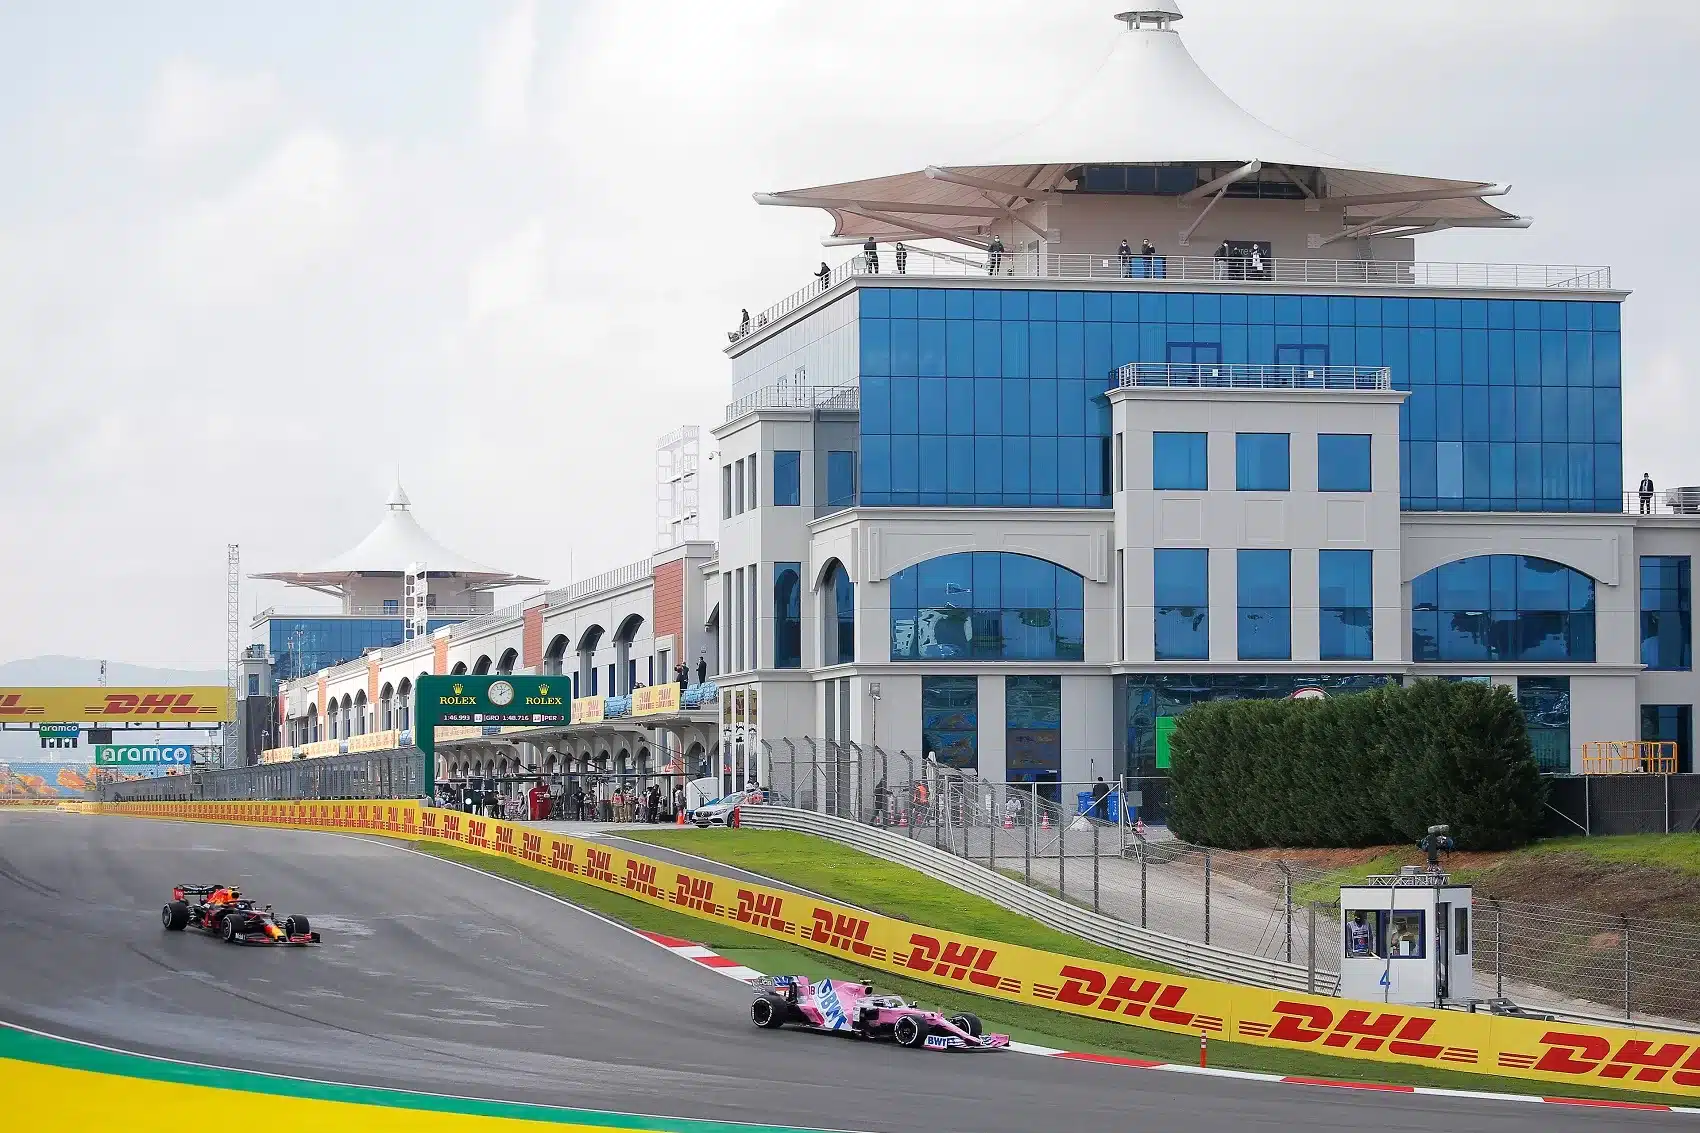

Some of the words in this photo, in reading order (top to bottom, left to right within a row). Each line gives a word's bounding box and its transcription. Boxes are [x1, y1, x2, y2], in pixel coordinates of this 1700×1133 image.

[102, 694, 201, 714] DHL
[439, 696, 477, 705] ROLEX
[525, 697, 562, 705] ROLEX
[102, 747, 188, 762] aramco
[443, 814, 461, 842] DHL
[468, 819, 488, 849] DHL
[496, 825, 514, 855] DHL
[522, 832, 543, 865] DHL
[551, 841, 574, 873] DHL
[586, 848, 613, 883] DHL
[626, 859, 658, 899] DHL
[675, 873, 716, 915] DHL
[736, 888, 786, 932] DHL
[811, 908, 874, 957] DHL
[906, 933, 1001, 989] DHL
[1056, 965, 1194, 1026] DHL
[1268, 1000, 1443, 1060] DHL
[1379, 969, 1391, 986] 4
[808, 985, 816, 996] 18
[820, 993, 848, 1029] BWT
[927, 1035, 948, 1047] BWT
